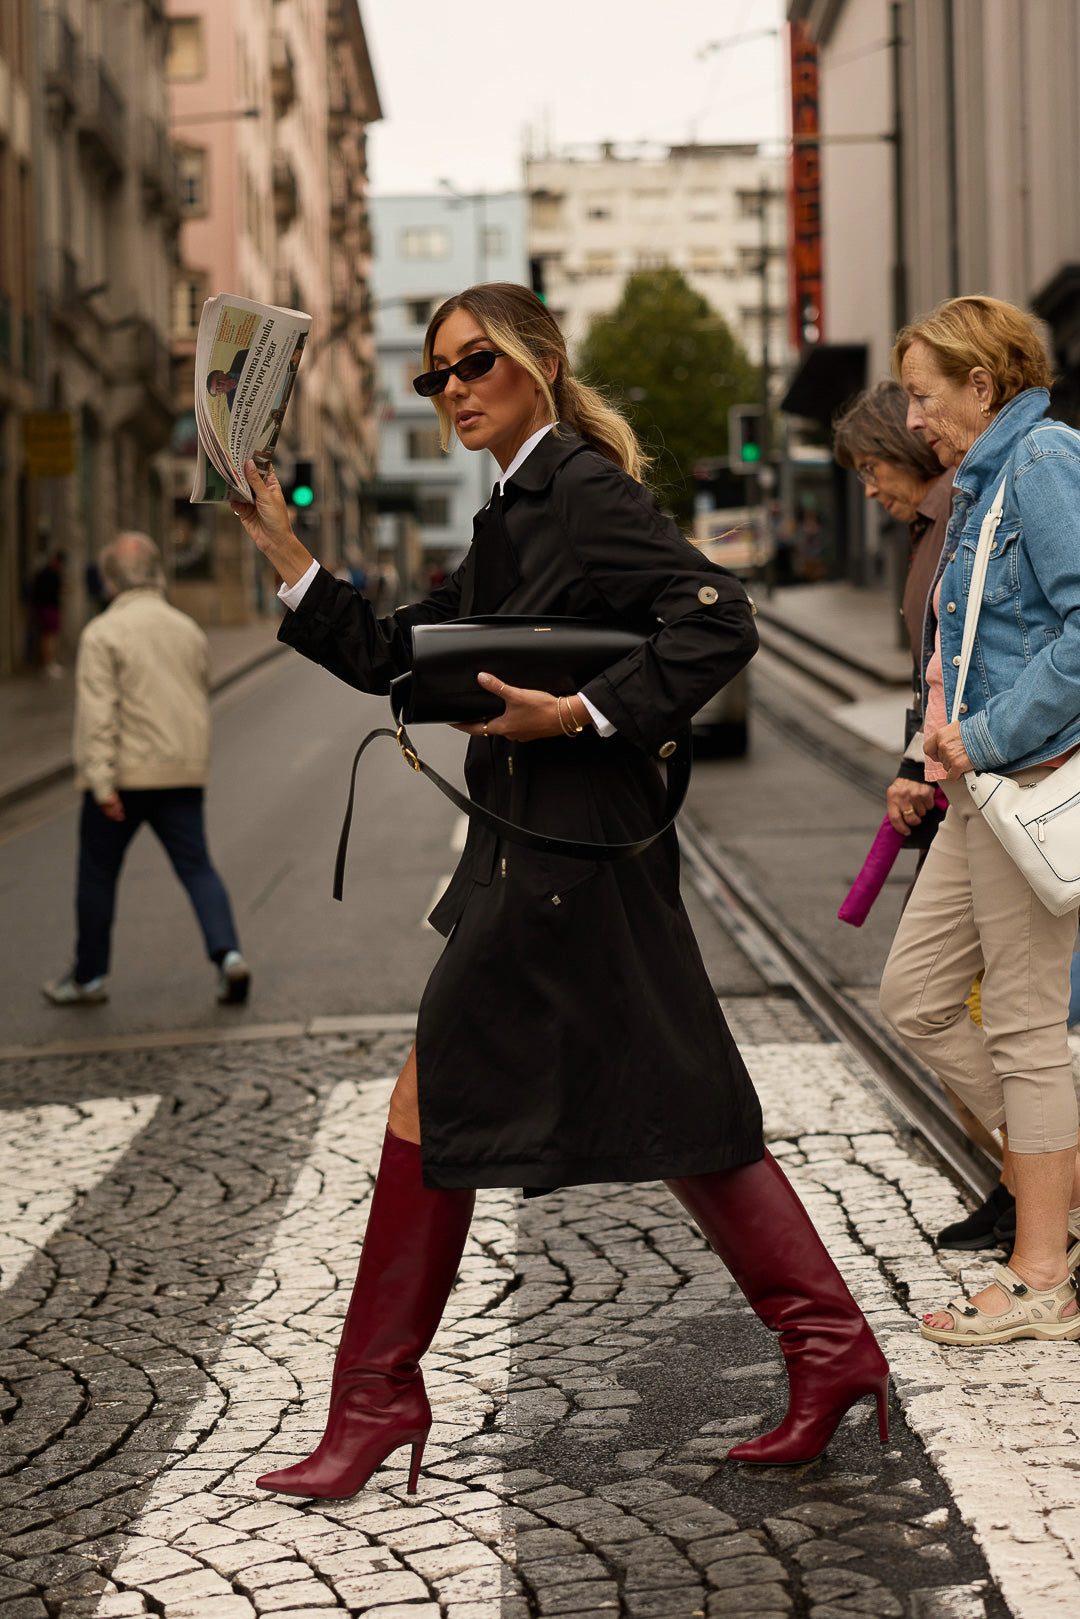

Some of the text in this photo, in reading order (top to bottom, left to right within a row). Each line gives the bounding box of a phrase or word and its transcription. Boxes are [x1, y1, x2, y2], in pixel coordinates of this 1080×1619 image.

[262, 340, 277, 368] pagar
[230, 421, 238, 450] banca
[234, 385, 248, 420] acabou
[245, 359, 260, 385] numa
[255, 346, 263, 358] só
[259, 319, 275, 347] multa
[255, 366, 267, 385] por
[245, 384, 260, 408] ficou
[241, 408, 251, 427] que
[235, 427, 245, 454] euros
